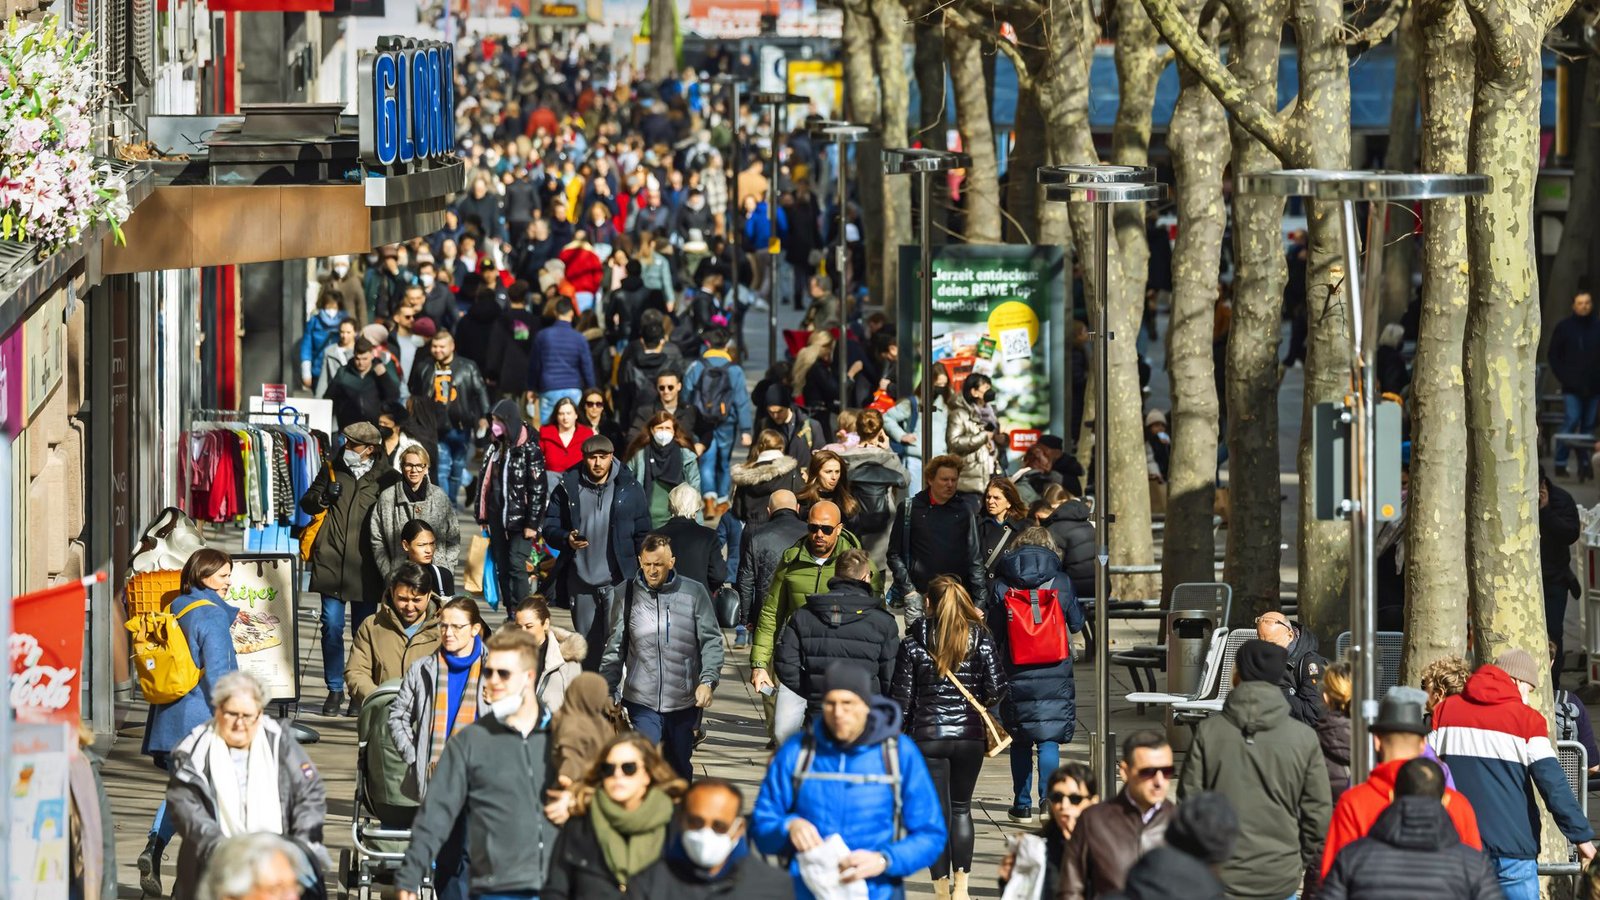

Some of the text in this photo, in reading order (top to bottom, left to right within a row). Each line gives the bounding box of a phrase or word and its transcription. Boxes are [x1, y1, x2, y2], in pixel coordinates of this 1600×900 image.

[976, 268, 1038, 281] entdecken:
[937, 283, 1036, 299] deine REWE Top-
[225, 584, 278, 608] rêpes
